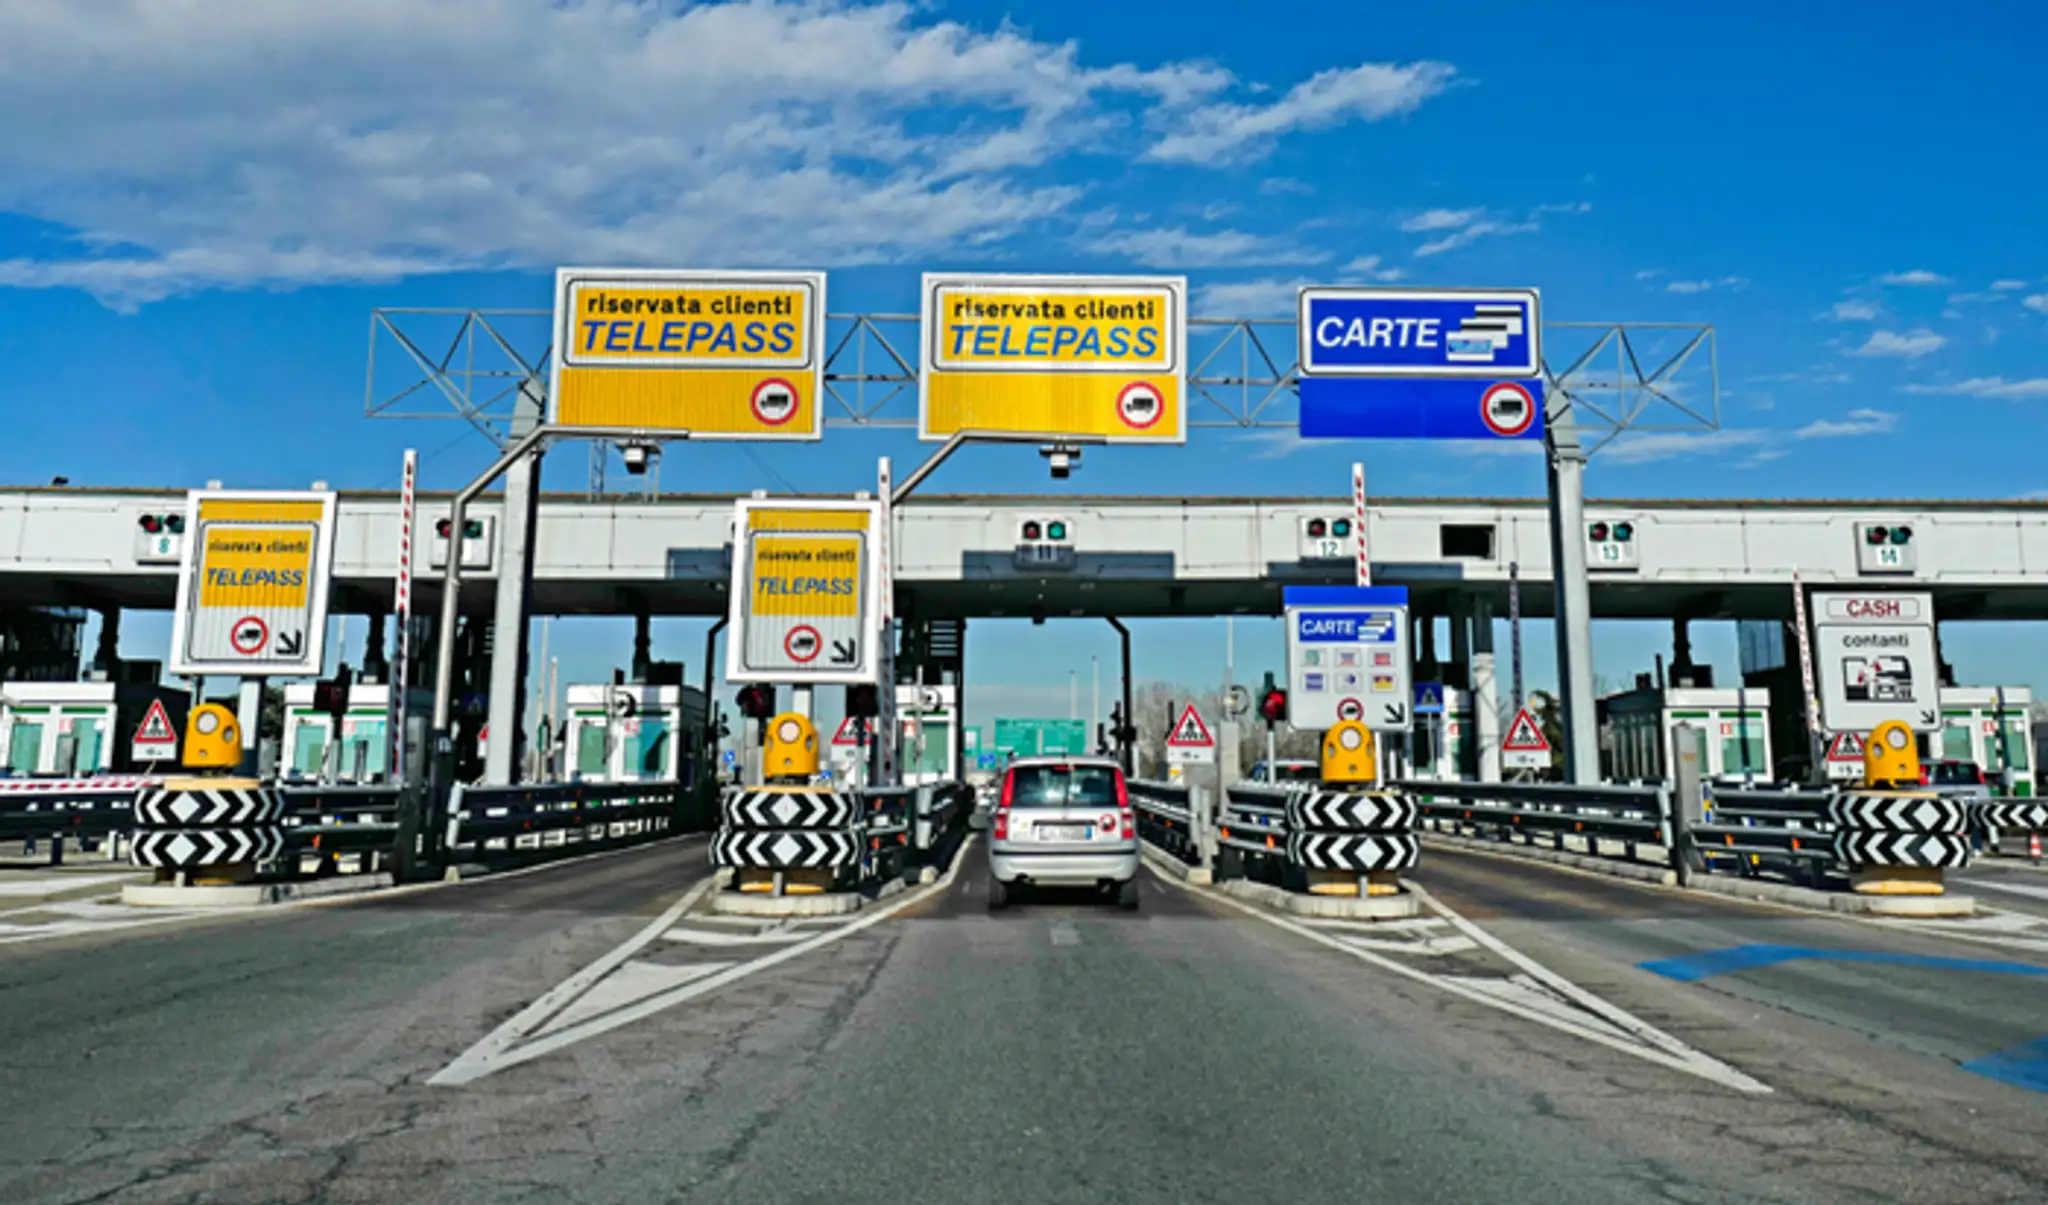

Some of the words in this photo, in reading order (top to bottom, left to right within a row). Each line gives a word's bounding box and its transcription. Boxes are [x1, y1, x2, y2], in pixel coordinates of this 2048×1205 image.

[587, 293, 702, 315] riservata
[710, 294, 792, 315] clienti
[953, 298, 1066, 319] riservata
[1074, 299, 1154, 320] clienti
[582, 320, 796, 353] TELEPASS
[950, 325, 1159, 357] TELEPASS
[1316, 315, 1441, 347] CARTE
[1321, 541, 1338, 558] 12
[1603, 544, 1619, 561] 13
[1881, 549, 1897, 564] 14
[207, 567, 304, 587] TELEPASS
[757, 575, 854, 595] TELEPASS
[1846, 599, 1900, 618] CASH
[1301, 618, 1356, 636] CARTE
[1842, 632, 1910, 648] contanti
